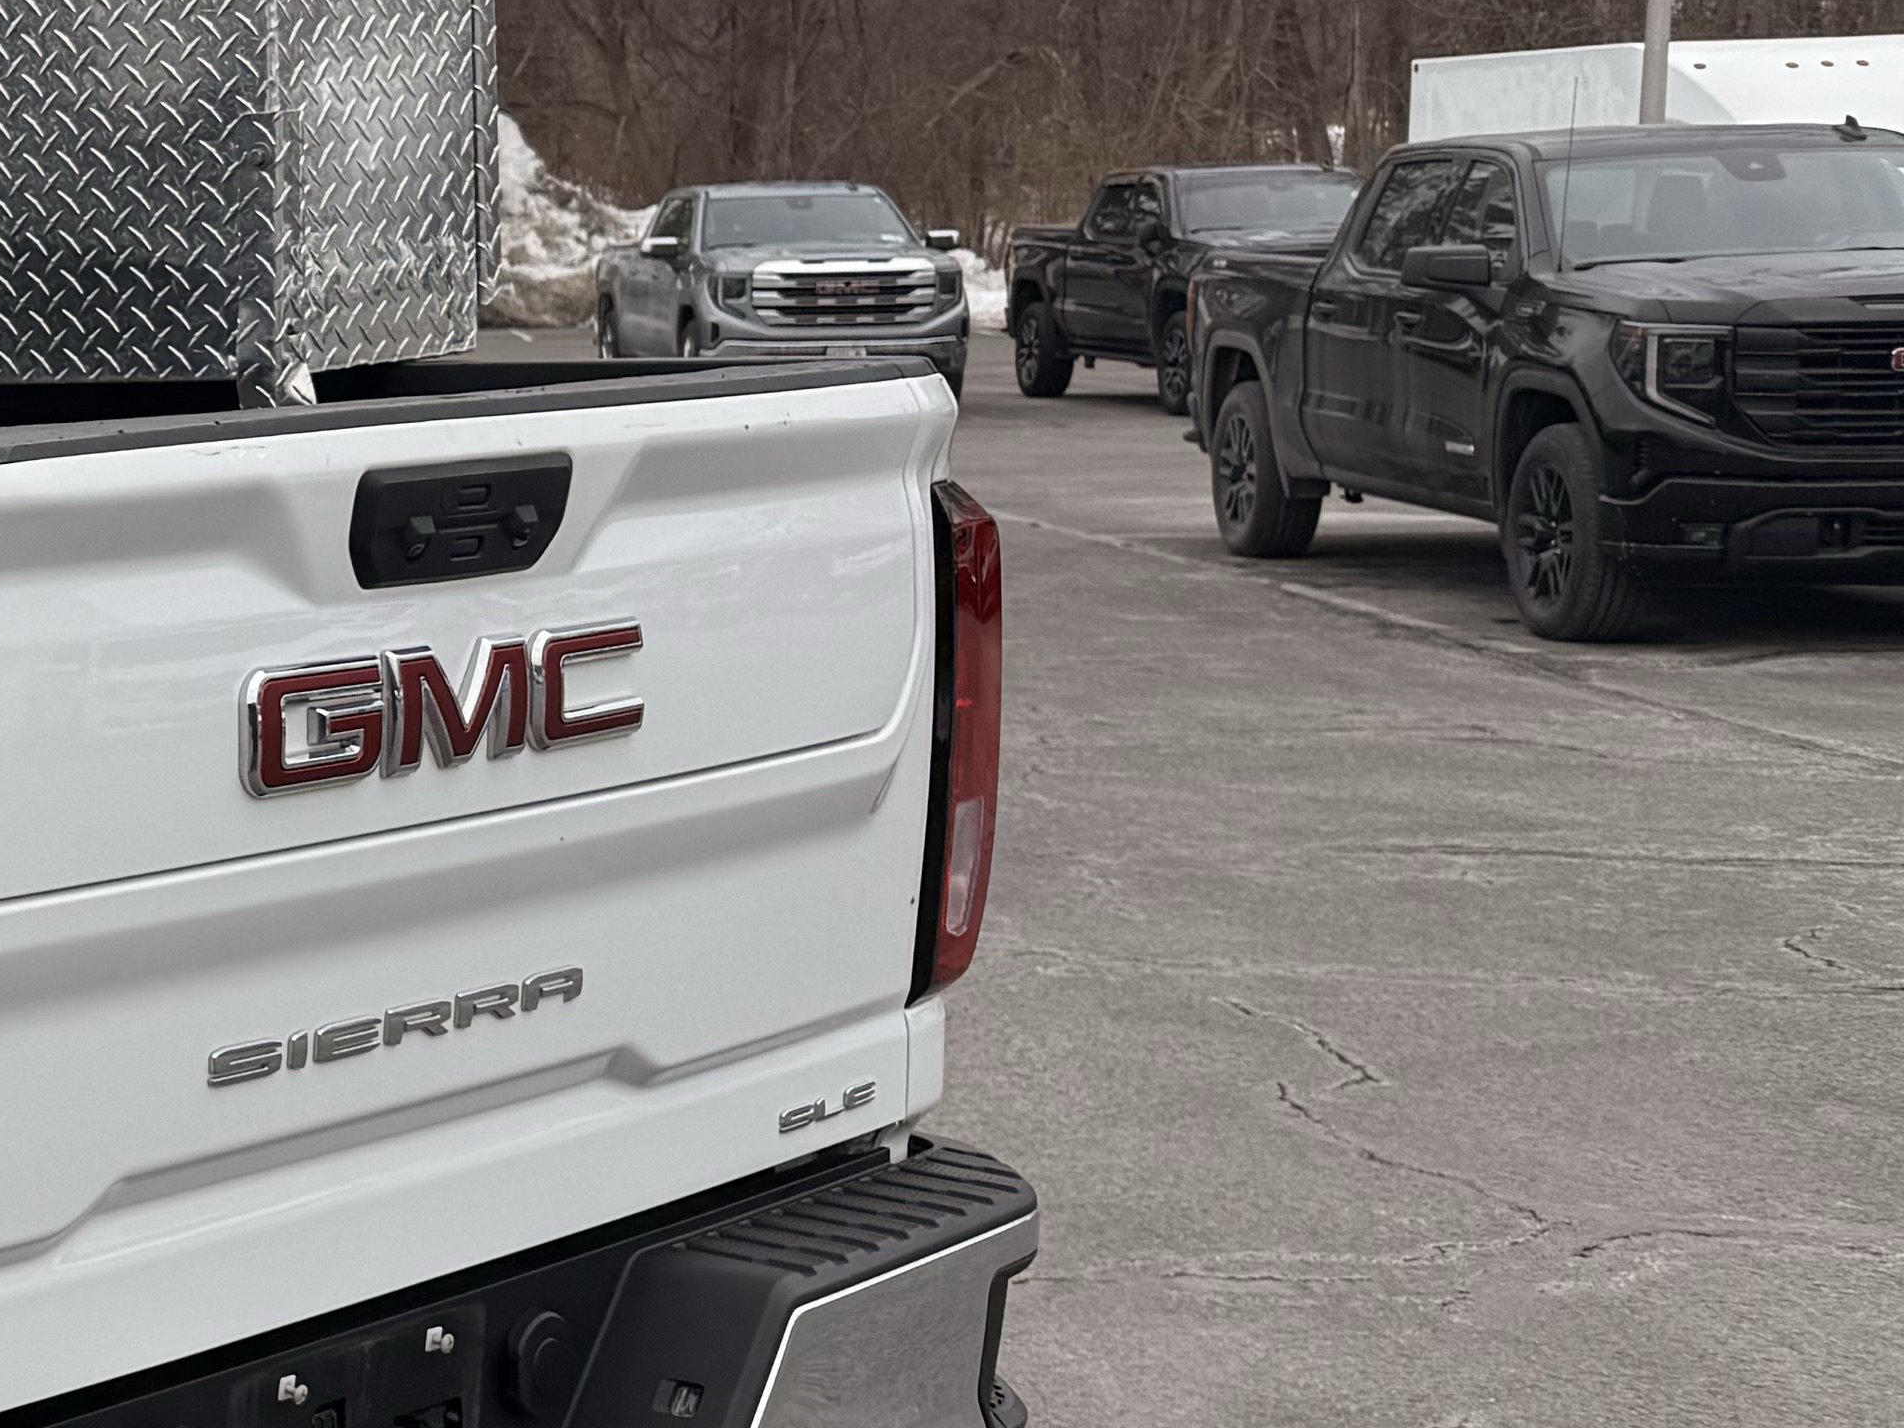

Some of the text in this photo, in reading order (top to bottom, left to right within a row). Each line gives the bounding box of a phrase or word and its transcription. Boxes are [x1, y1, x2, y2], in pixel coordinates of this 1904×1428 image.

[238, 616, 644, 800] GMC
[207, 964, 583, 1087] SIERRA
[779, 1080, 876, 1133] SLE
